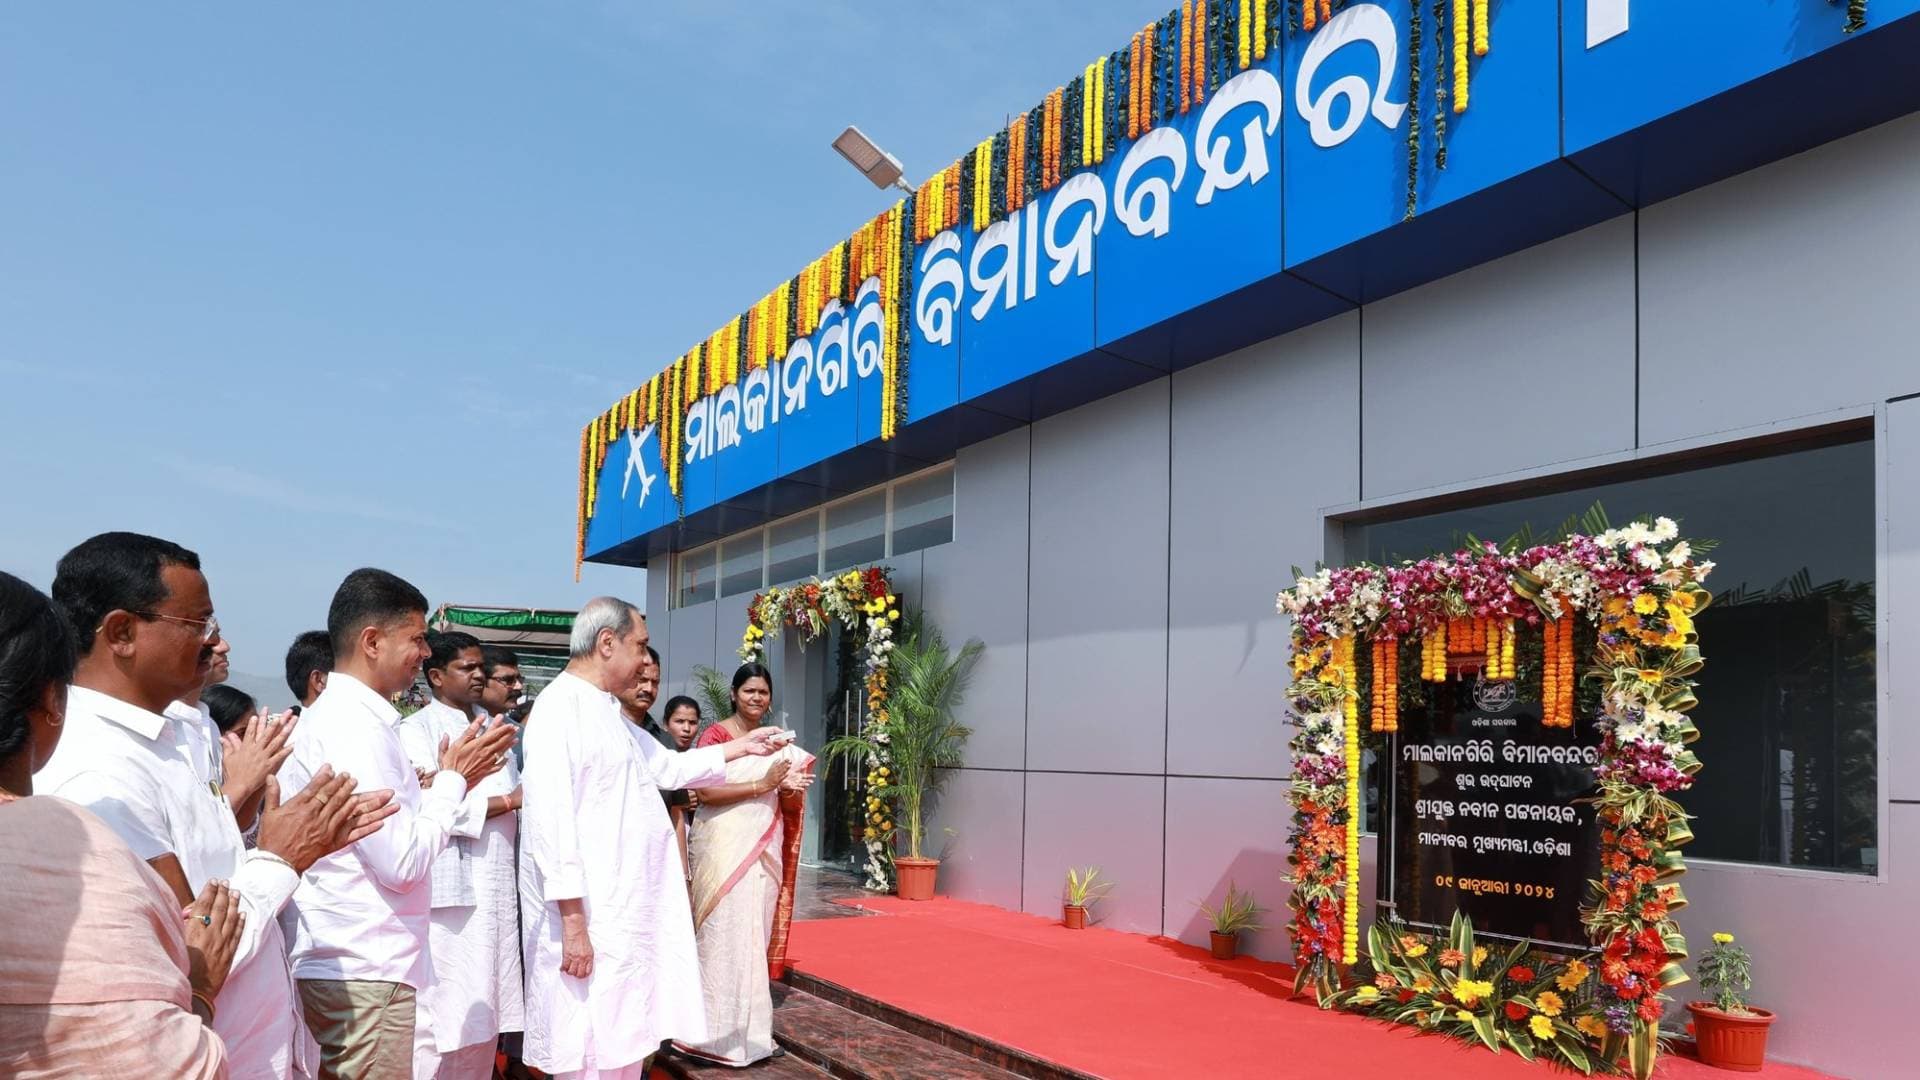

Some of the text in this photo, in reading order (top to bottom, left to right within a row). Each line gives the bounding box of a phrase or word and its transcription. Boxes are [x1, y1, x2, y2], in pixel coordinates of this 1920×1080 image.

[685, 3, 1408, 464] ମାଲକାନଗିରି ବିମାନବନ୍ଦର
[1403, 739, 1599, 765] ମାଲକାନଗିରି ବିମାନବନ୍ଦର
[1455, 773, 1476, 791] ଶୁଭ
[1415, 799, 1455, 821] ଶ୍ରୀଯୁକ୍ତ
[1458, 801, 1500, 818] ନବୀନ
[1417, 831, 1468, 849] ମାନ୍ୟବର
[1435, 875, 1555, 899] ୦୯ ଜାନୁଆରୀ ୨୦୨୪
